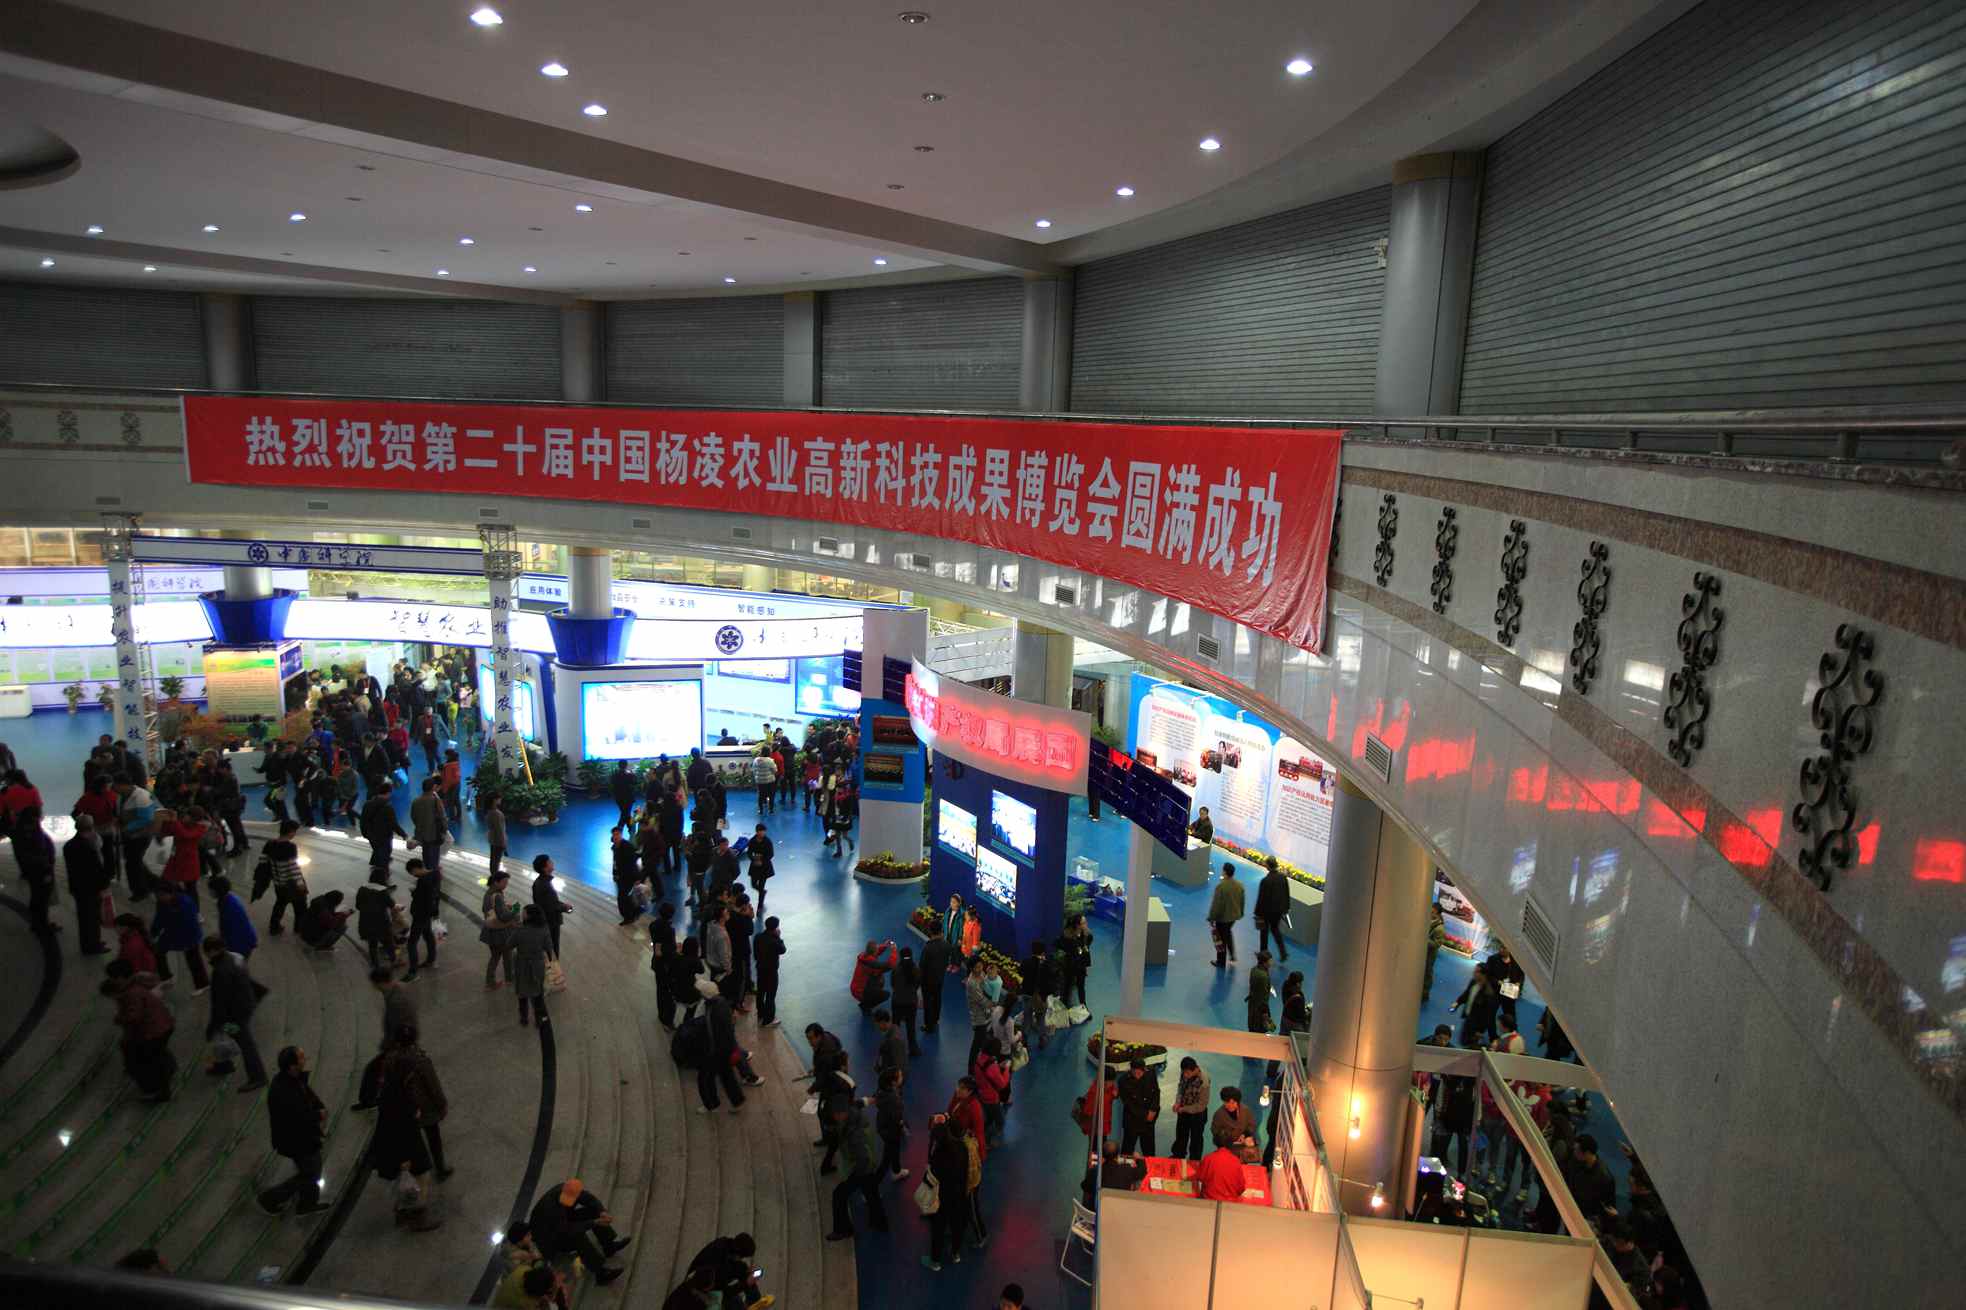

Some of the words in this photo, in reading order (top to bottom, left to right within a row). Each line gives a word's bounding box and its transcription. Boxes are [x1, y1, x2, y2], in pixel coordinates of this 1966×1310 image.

[245, 416, 1283, 586] 热烈祝贺第二十届中国杨凌农业高新科技成果博览会圆满成功
